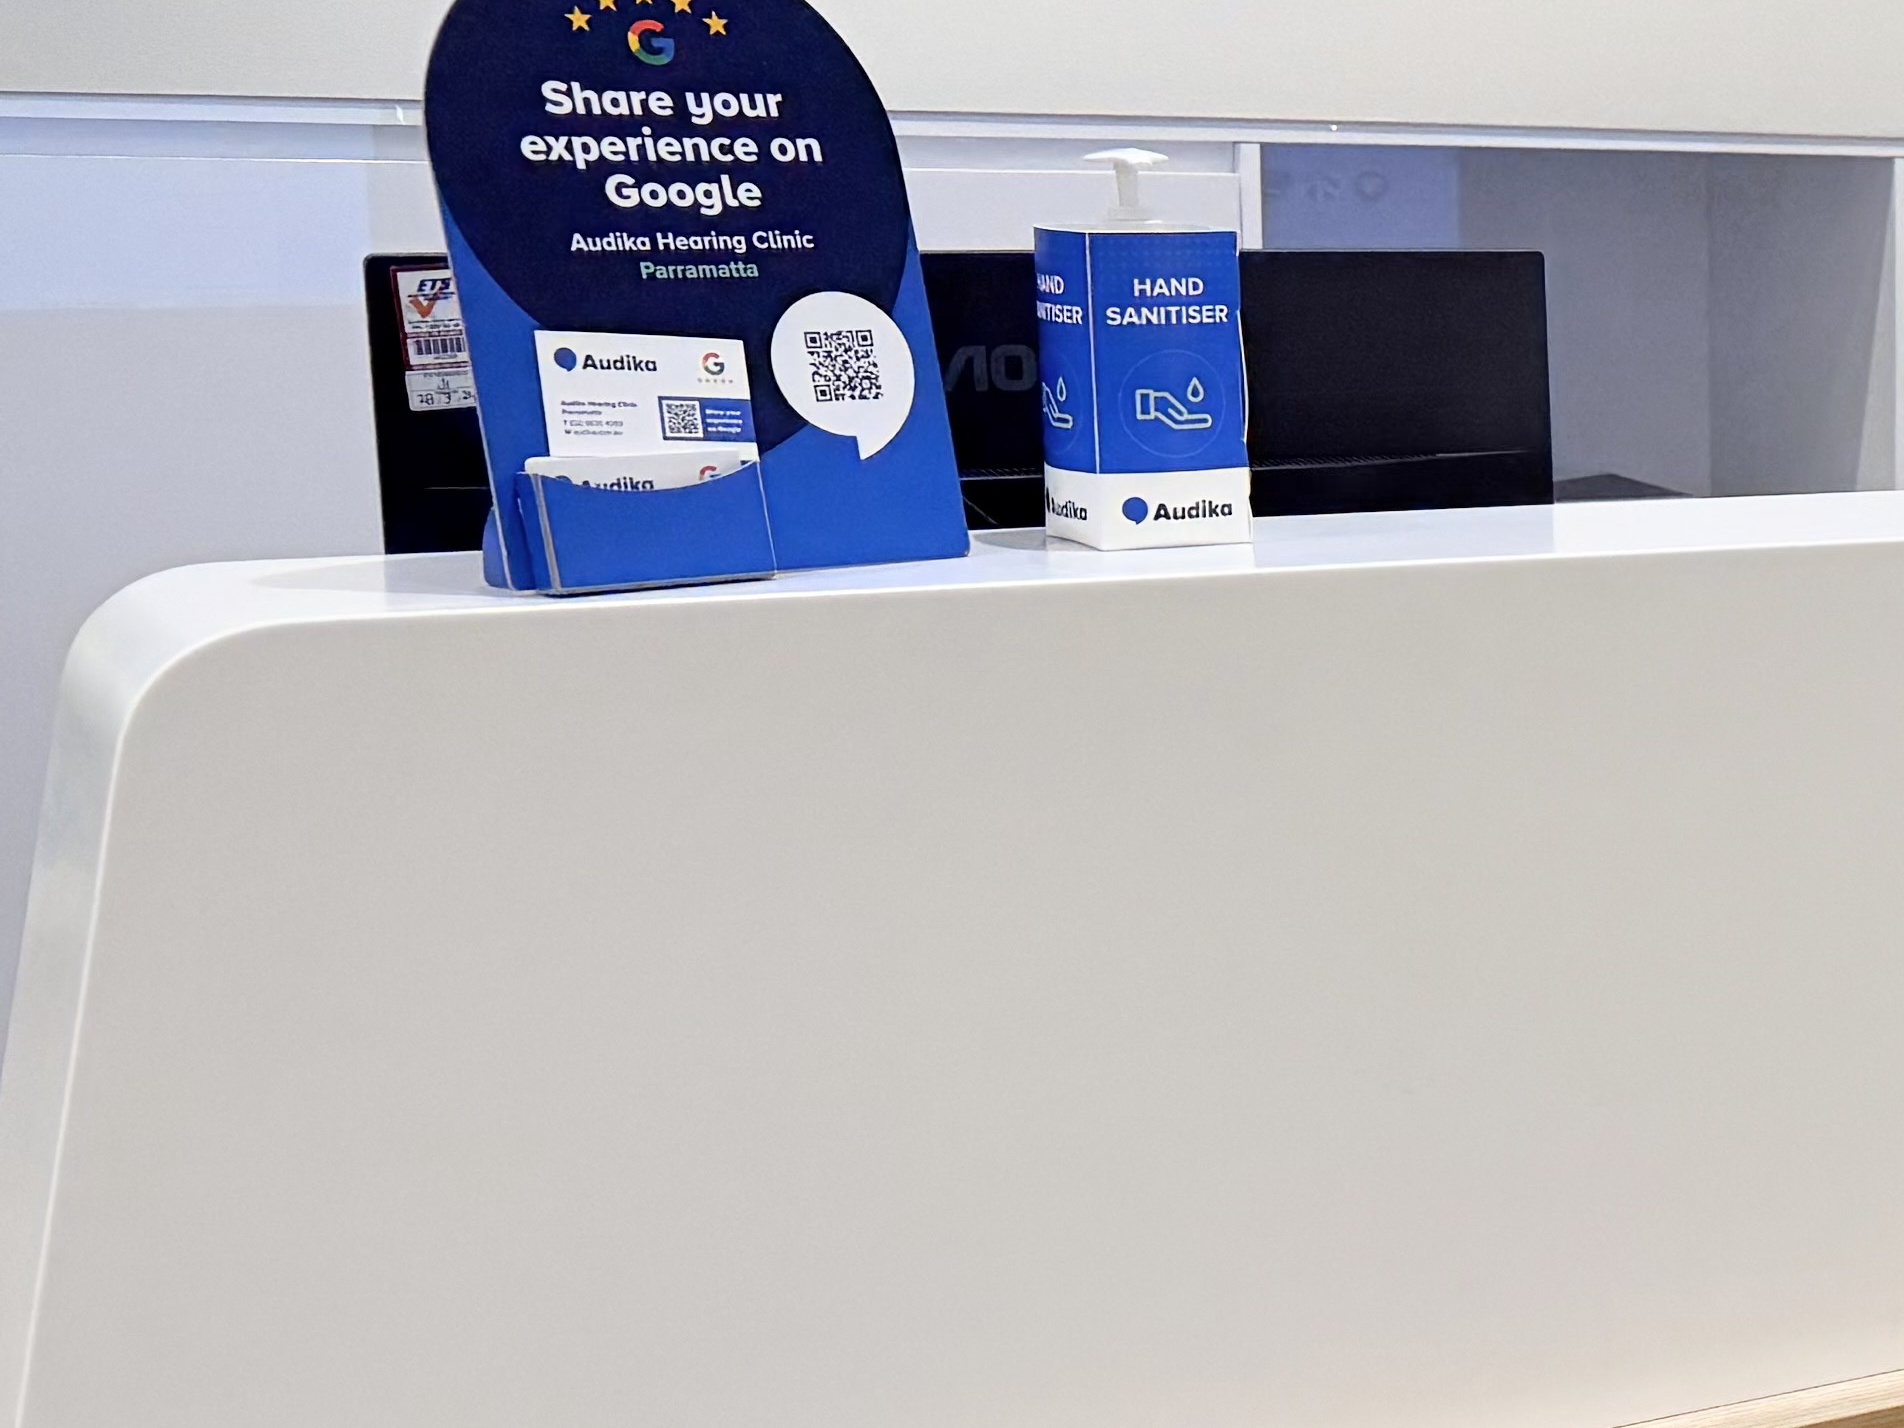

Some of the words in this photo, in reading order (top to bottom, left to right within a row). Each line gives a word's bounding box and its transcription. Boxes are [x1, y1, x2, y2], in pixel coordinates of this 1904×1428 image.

[541, 79, 674, 116] Share
[685, 91, 783, 125] your
[520, 126, 759, 170] experience
[769, 135, 824, 162] on
[604, 173, 762, 216] Google
[570, 231, 651, 253] Audika
[656, 230, 747, 254] Hearing
[752, 229, 815, 250] Clinic
[639, 260, 759, 280] Parramatta
[1133, 276, 1204, 297] HAND
[1106, 304, 1229, 326] SANITISER
[582, 353, 658, 372] Audika
[1153, 498, 1233, 521] Audika
